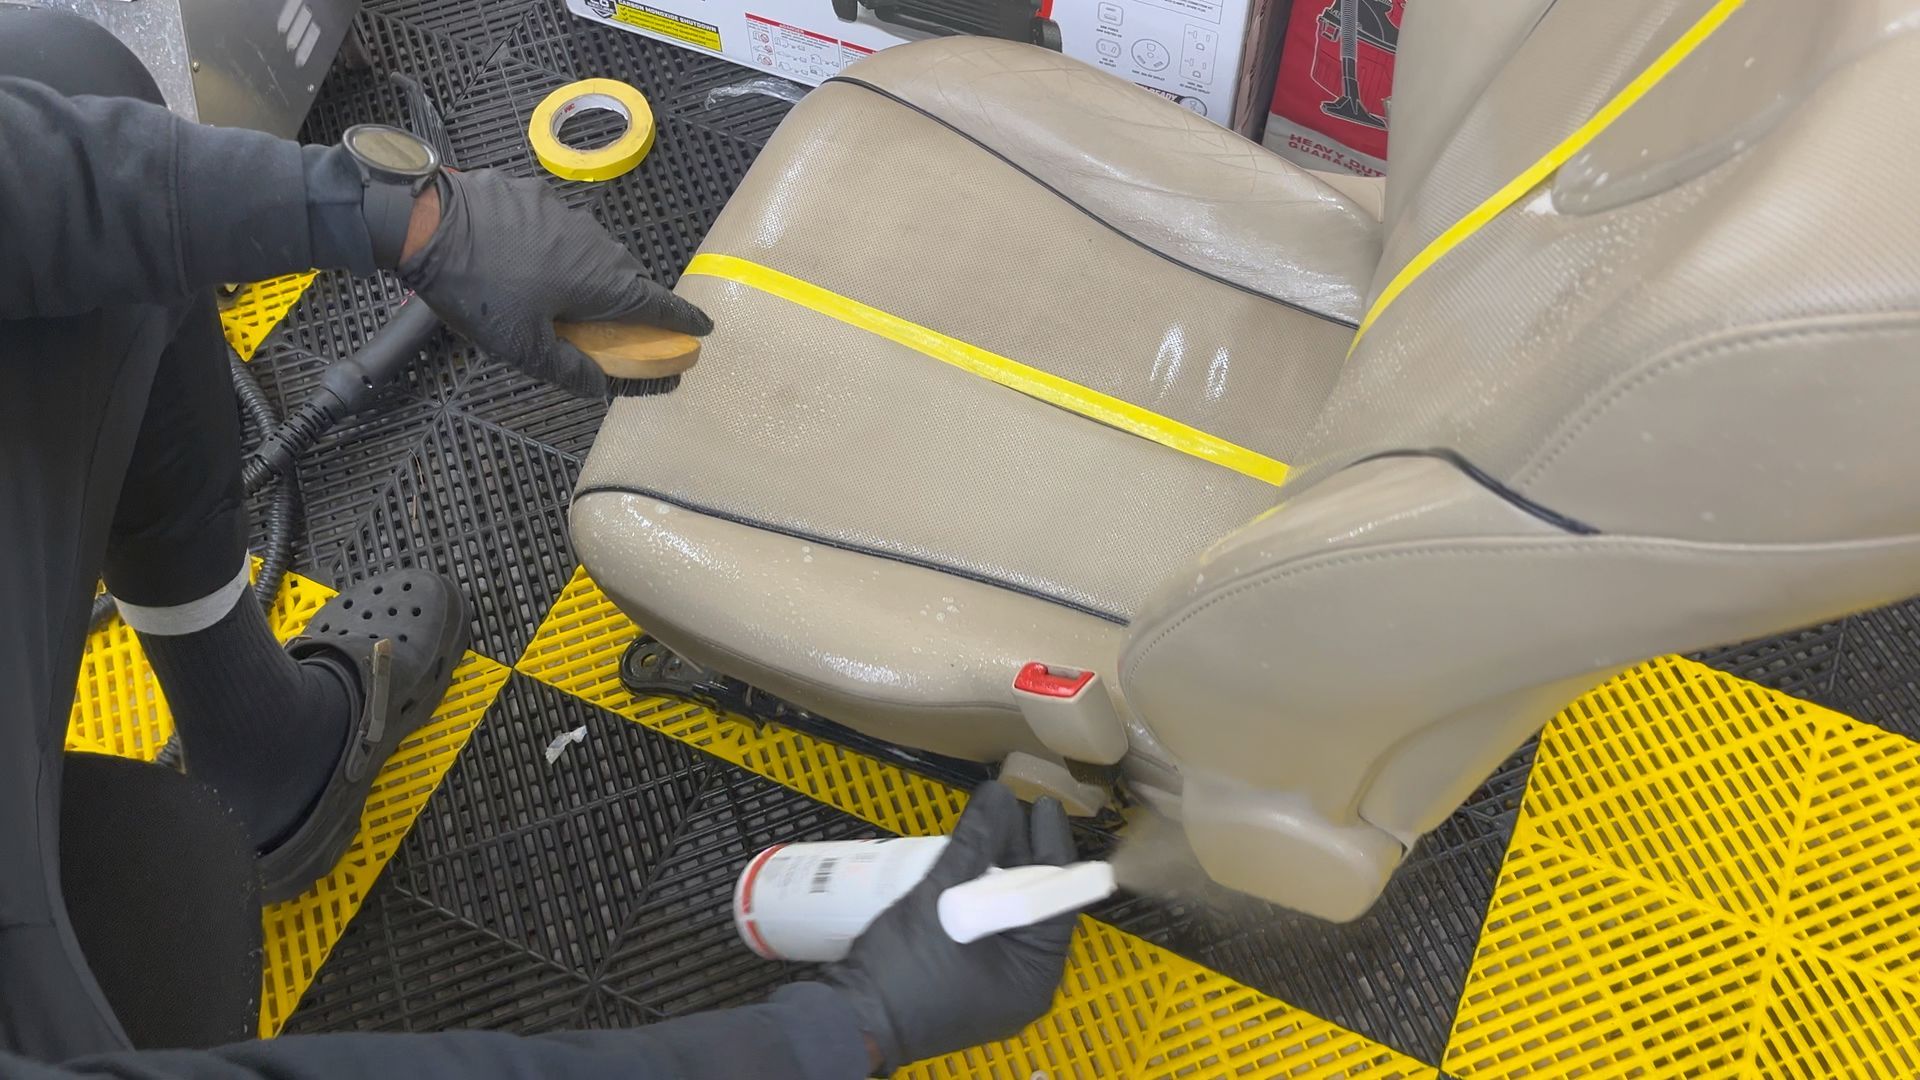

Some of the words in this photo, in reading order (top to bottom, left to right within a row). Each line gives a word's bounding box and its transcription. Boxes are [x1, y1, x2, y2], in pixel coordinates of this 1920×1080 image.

[679, 16, 717, 33] SHUTDOWN
[1290, 134, 1345, 160] HEAVY
[1349, 158, 1388, 177] DUT
